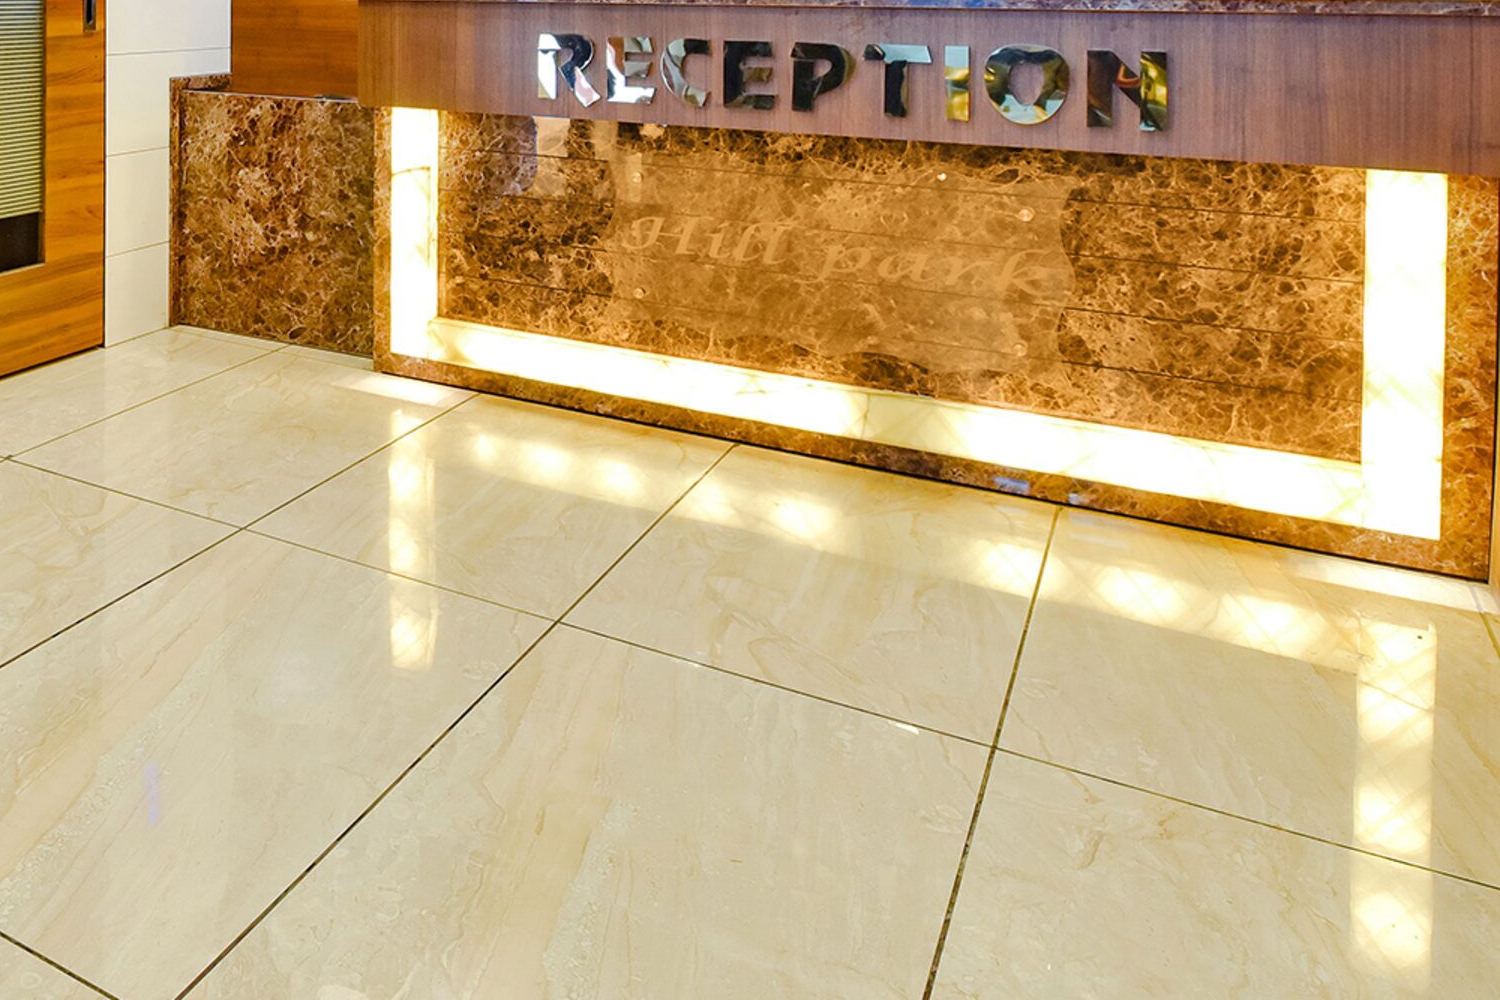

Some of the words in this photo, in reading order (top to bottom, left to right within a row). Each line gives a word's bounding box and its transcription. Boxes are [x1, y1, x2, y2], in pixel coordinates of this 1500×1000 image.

[535, 31, 1170, 133] RECEPTION
[625, 214, 794, 266] Hill
[797, 243, 1051, 296] park
